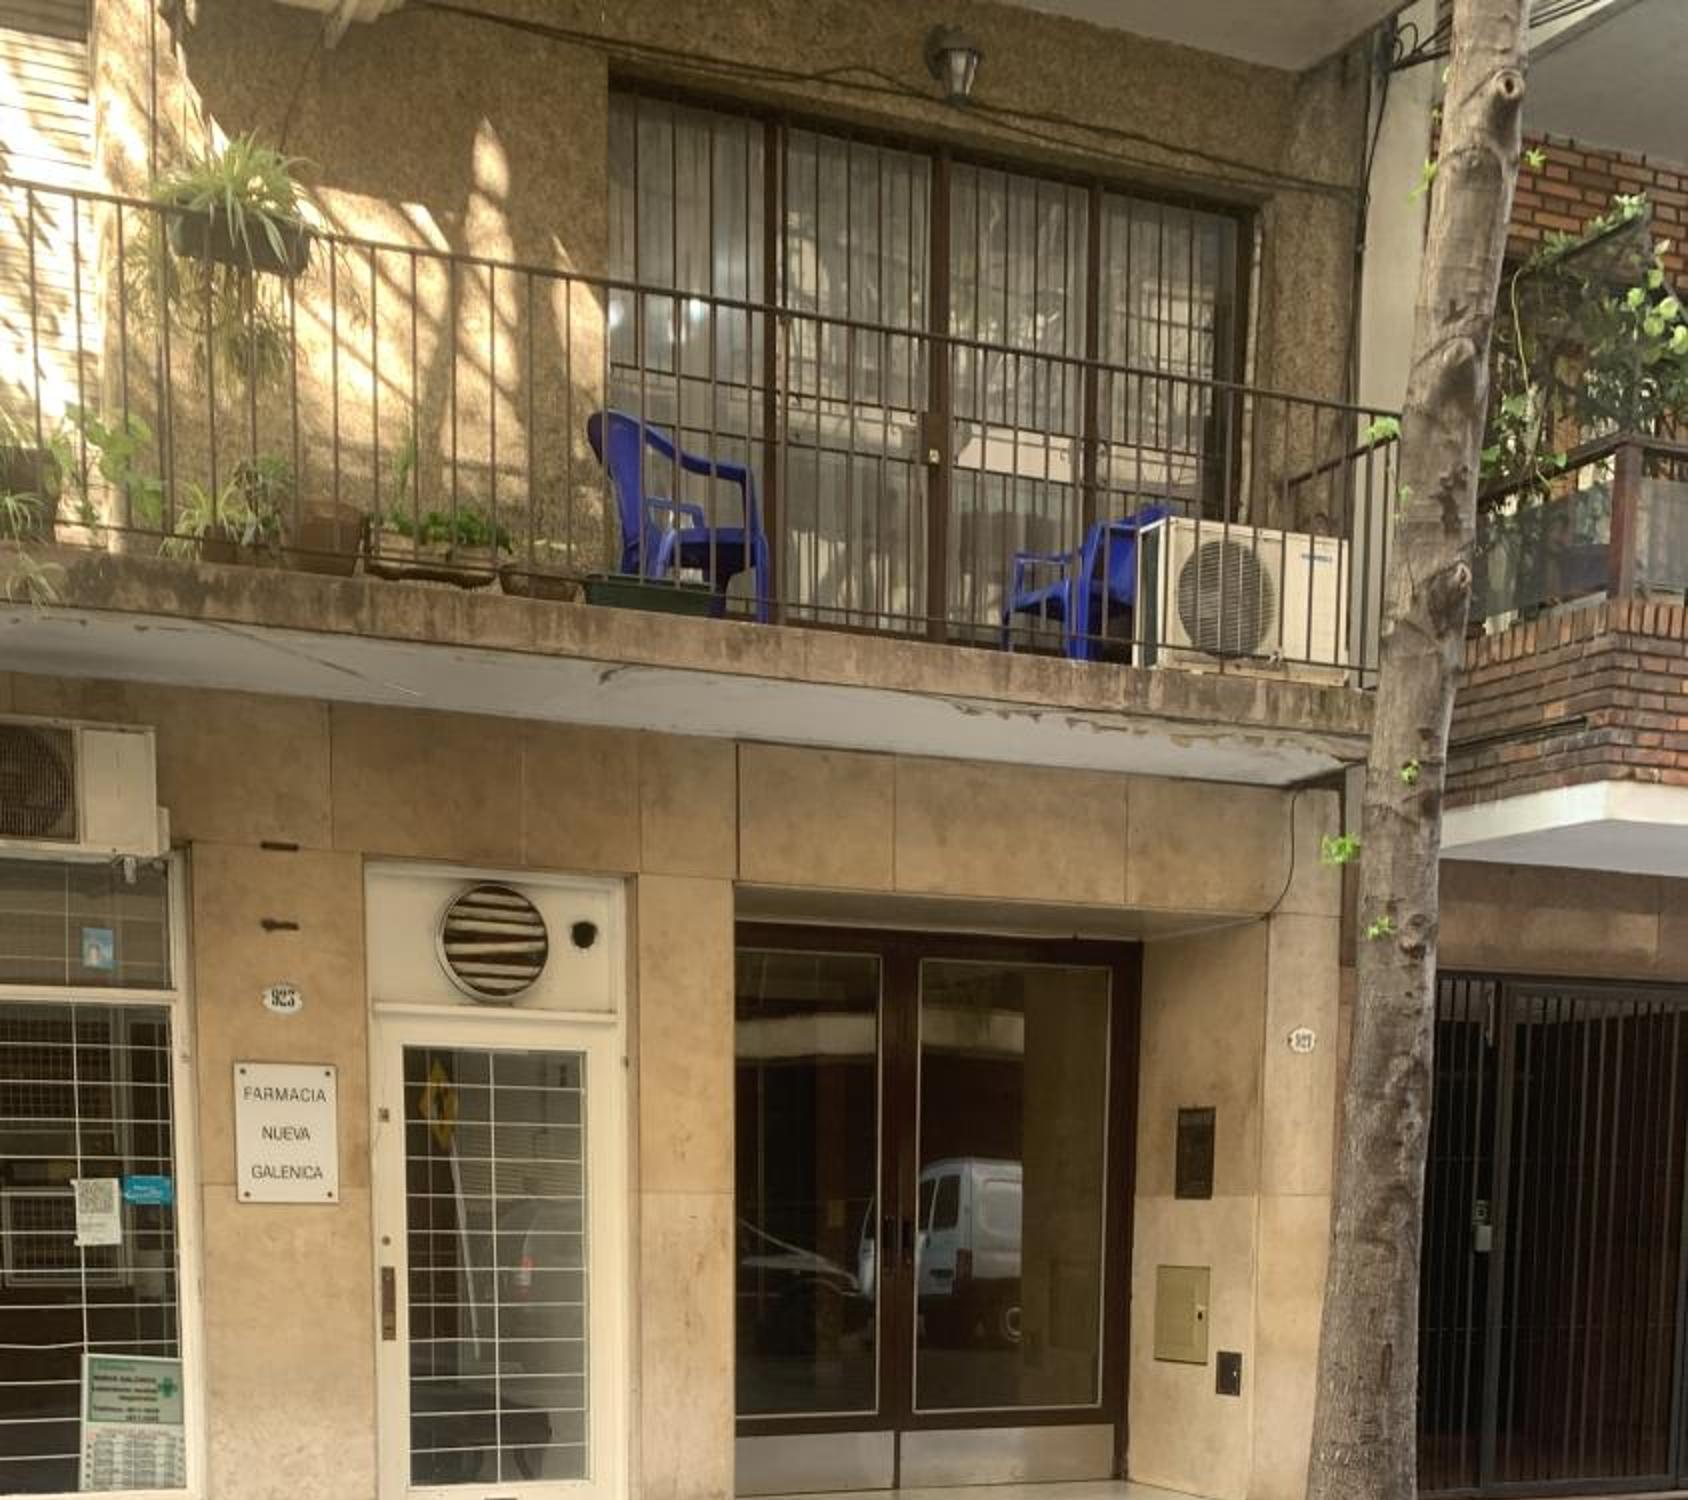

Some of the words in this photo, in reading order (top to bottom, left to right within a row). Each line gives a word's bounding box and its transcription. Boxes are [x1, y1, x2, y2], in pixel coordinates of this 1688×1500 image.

[271, 989, 295, 1006] 923
[243, 1087, 327, 1103] FARMACIA
[261, 1126, 311, 1141] NUEVA
[251, 1164, 323, 1179] GALENICA
